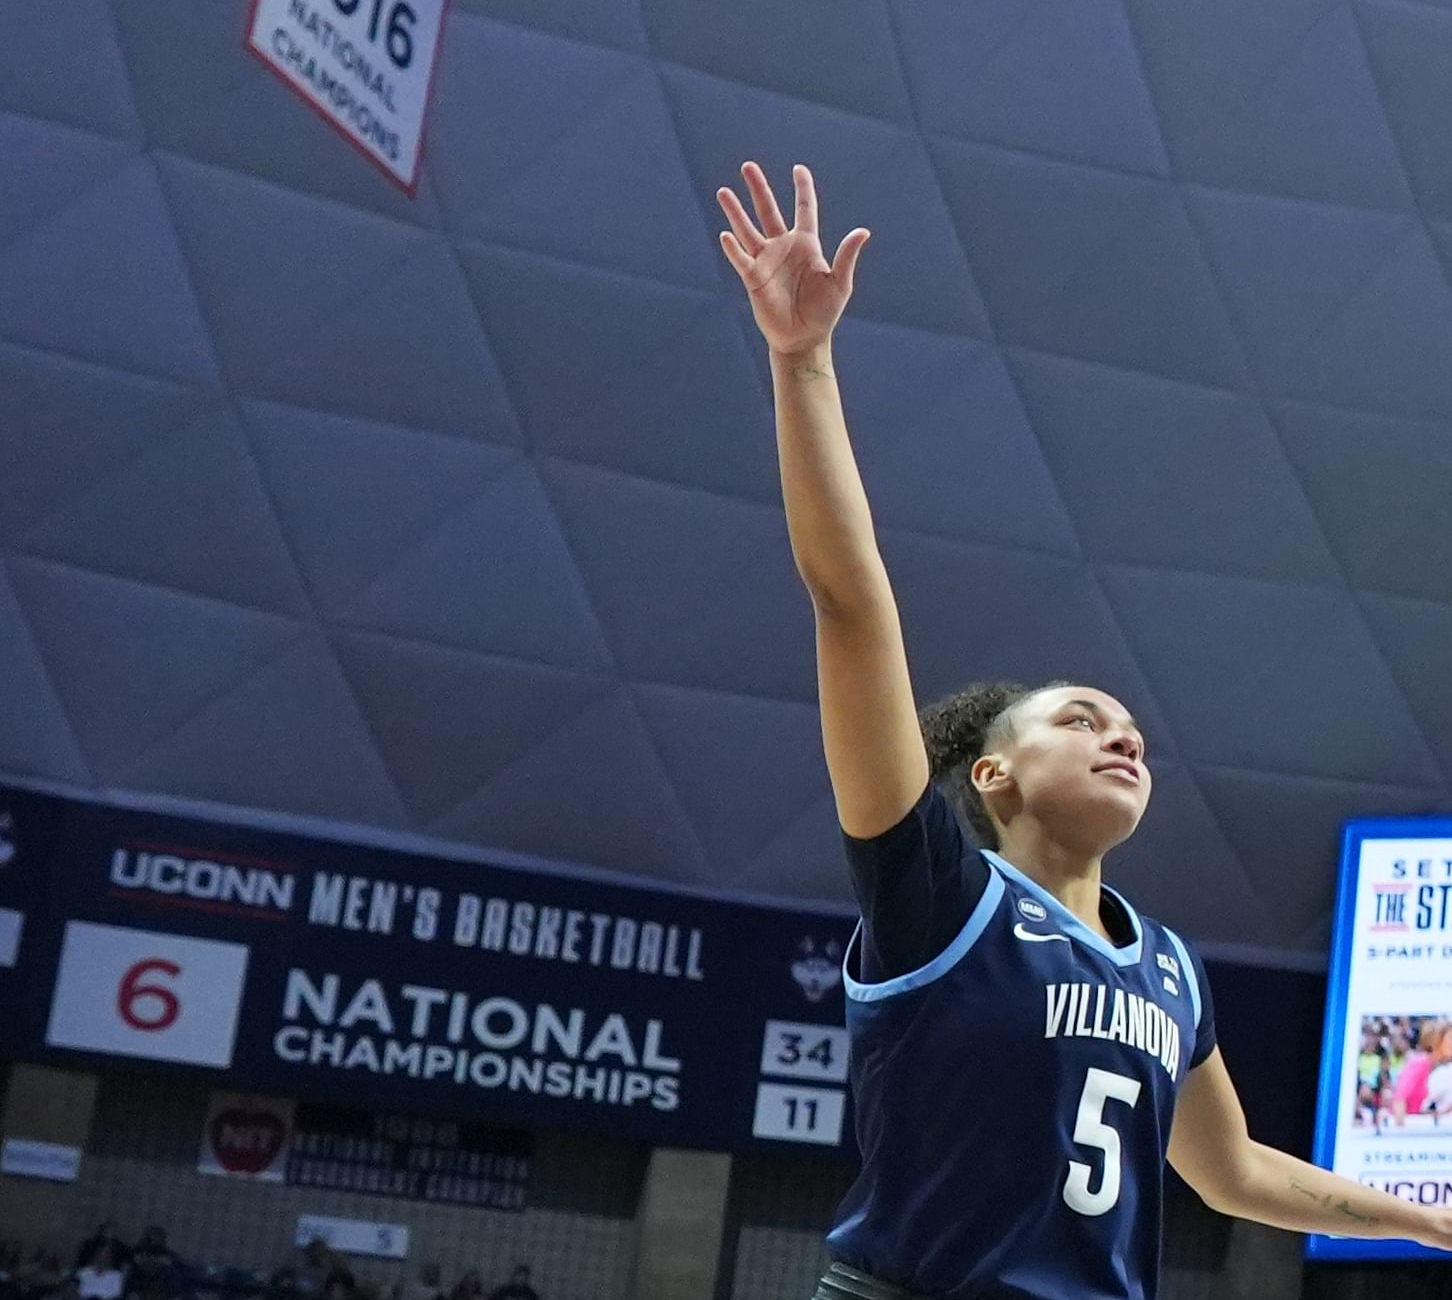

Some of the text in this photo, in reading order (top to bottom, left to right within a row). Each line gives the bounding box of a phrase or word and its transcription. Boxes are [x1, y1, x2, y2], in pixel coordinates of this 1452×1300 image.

[272, 25, 400, 161] CHAMPIONS
[108, 848, 704, 982] UCONN MEN'S BASKETBALL
[1375, 892, 1406, 925] THE
[115, 956, 184, 1032] 6
[282, 966, 682, 1072] NATIONAL
[1044, 983, 1181, 1083] VILLANOVA
[273, 1024, 681, 1112] CHAMPIONSHIPS
[776, 1031, 836, 1070] 34
[780, 1098, 819, 1133] 11
[1063, 1067, 1142, 1217] 5
